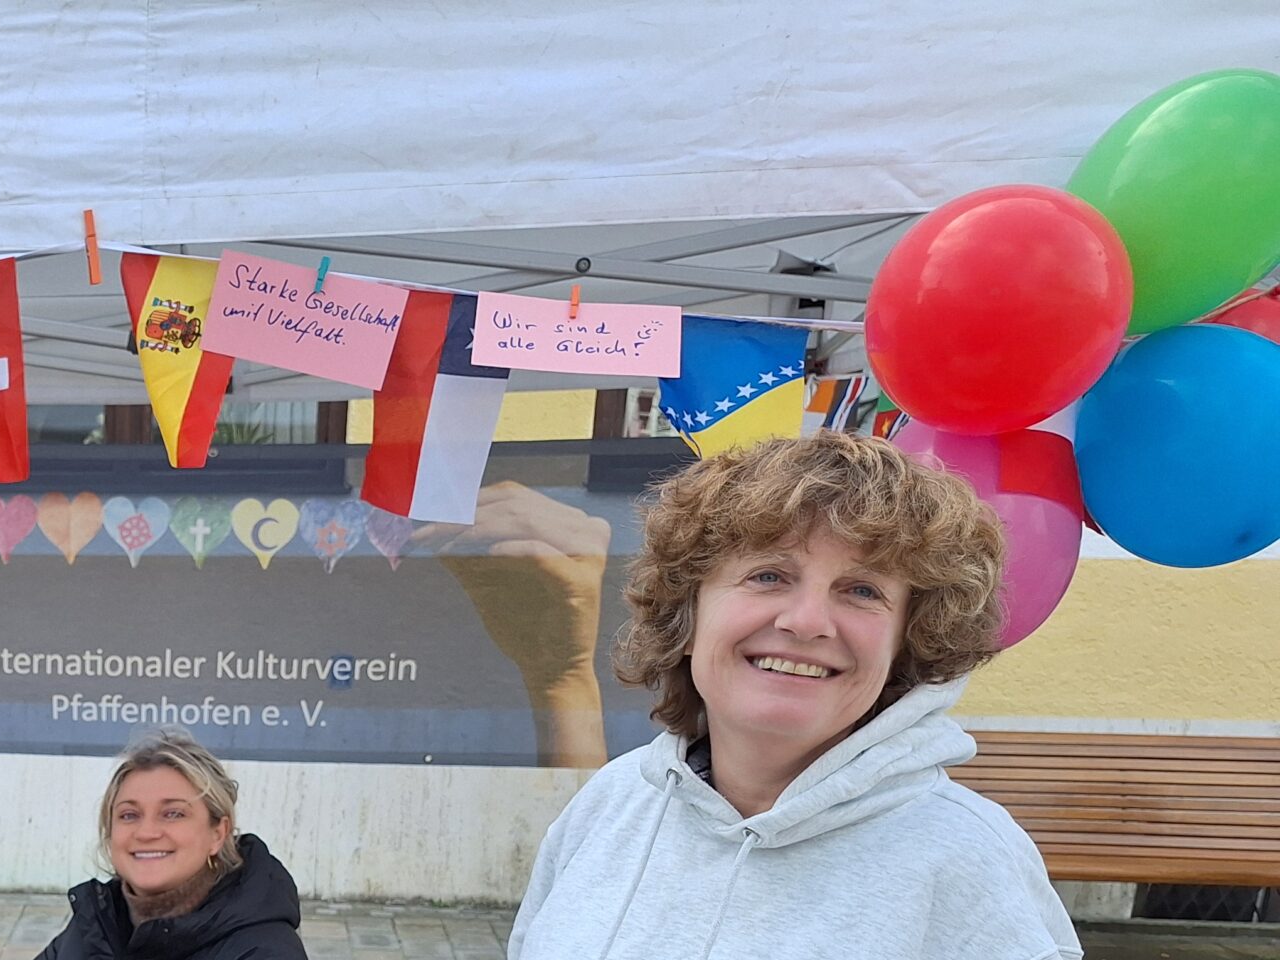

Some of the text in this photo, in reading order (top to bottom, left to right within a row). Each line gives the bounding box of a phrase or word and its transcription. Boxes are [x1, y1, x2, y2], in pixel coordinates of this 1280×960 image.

[229, 263, 401, 333] Starke Gesellschaft
[223, 302, 347, 346] mit Vielfalt.
[493, 311, 611, 335] Wir sind
[498, 337, 536, 350] alle
[216, 650, 418, 682] Kulturverein
[51, 694, 327, 727] Pfaffenhofen e. V.
